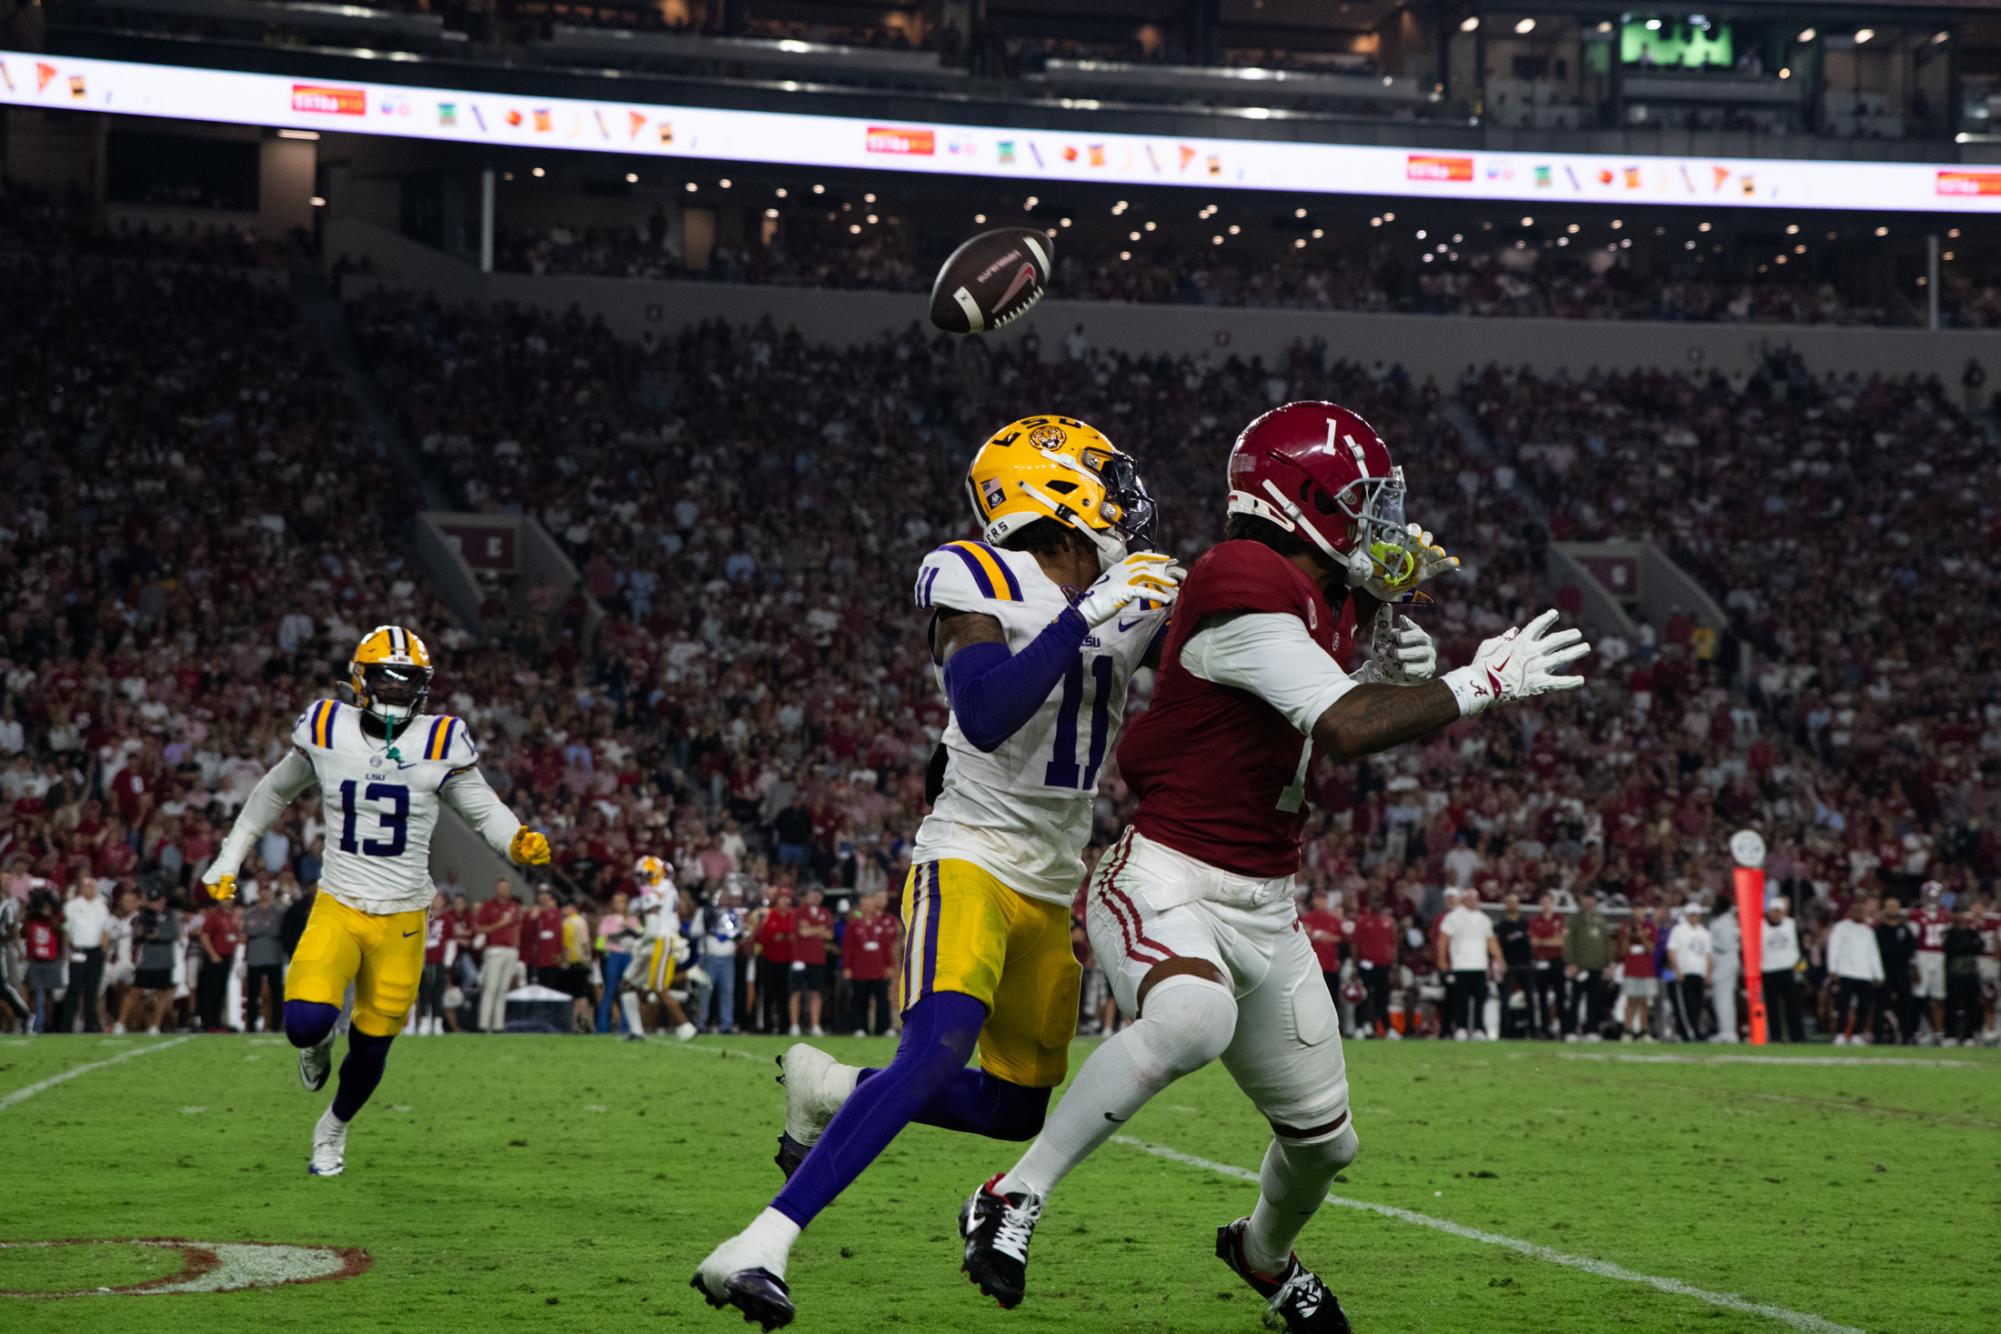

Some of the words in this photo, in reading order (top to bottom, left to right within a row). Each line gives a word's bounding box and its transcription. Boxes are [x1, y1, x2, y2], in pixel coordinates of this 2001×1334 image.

[1322, 418, 1337, 456] 1
[1044, 649, 1113, 790] 11
[365, 773, 386, 781] LSU
[340, 780, 410, 857] 13
